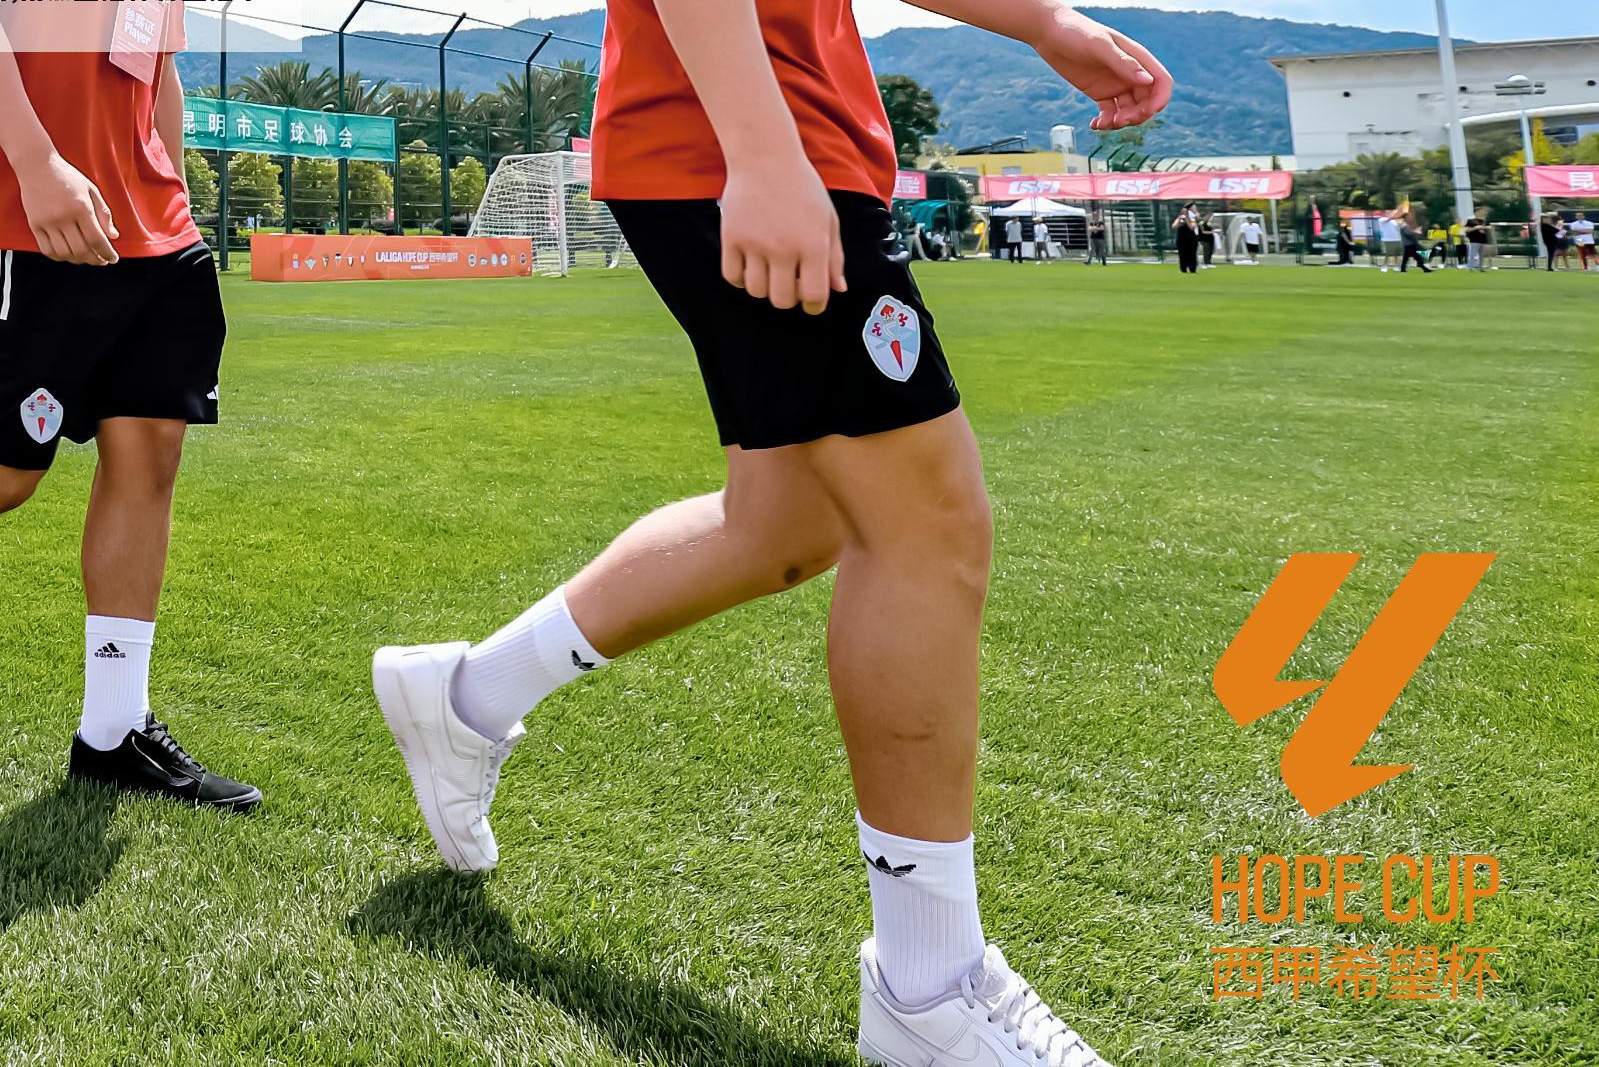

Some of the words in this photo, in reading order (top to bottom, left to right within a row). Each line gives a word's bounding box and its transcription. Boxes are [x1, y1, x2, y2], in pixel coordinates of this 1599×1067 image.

[123, 20, 151, 45] Player
[124, 7, 156, 37] 参赛证
[183, 111, 353, 149] 昆明市足球协会
[375, 251, 401, 263] LALIGA
